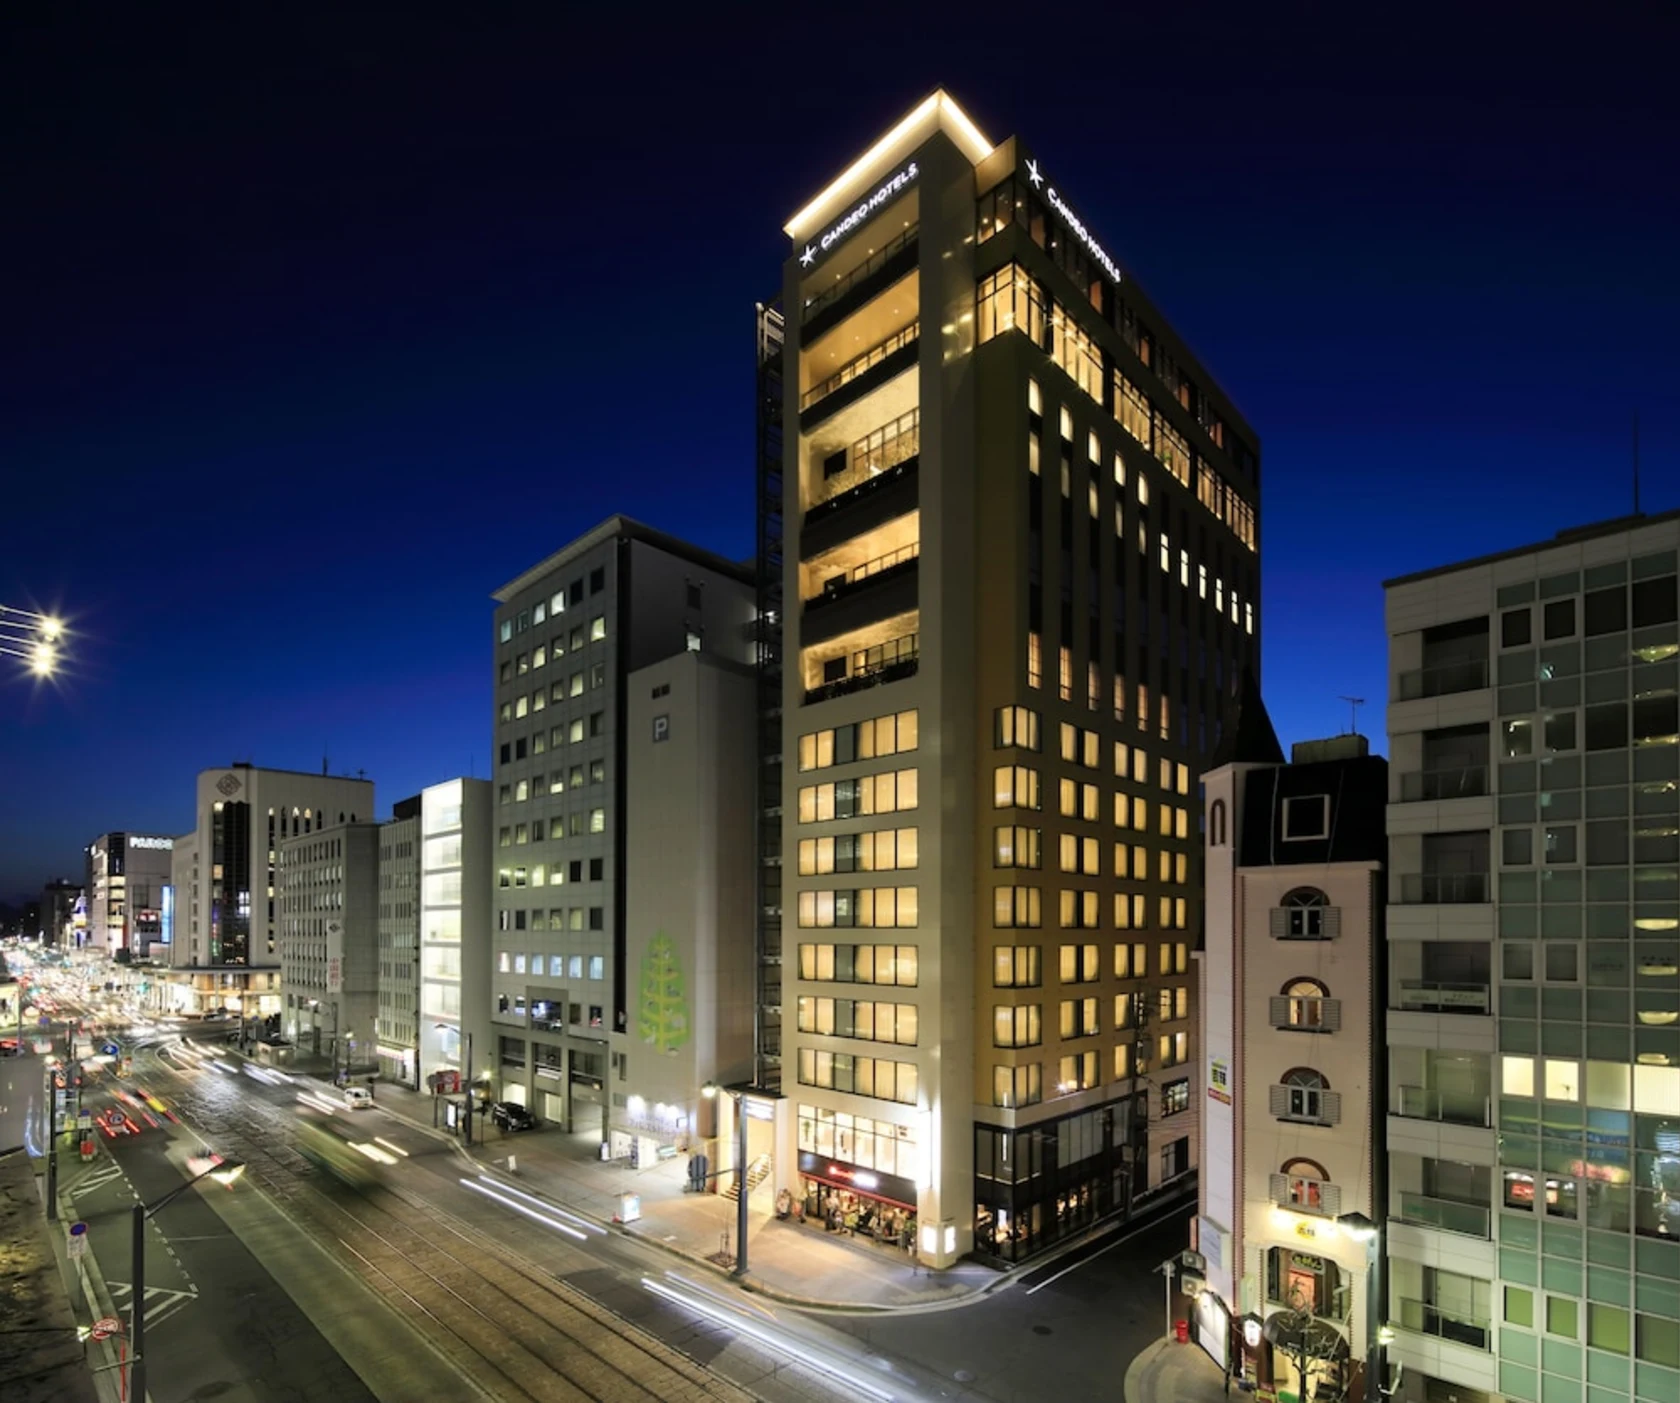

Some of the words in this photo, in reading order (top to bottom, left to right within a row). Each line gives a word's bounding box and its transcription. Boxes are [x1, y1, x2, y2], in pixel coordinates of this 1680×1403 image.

[821, 203, 868, 250] CANDEO
[869, 162, 919, 209] HOTELS
[1047, 187, 1088, 242] CANDEO
[1087, 235, 1121, 283] HOTELS
[655, 717, 667, 741] P
